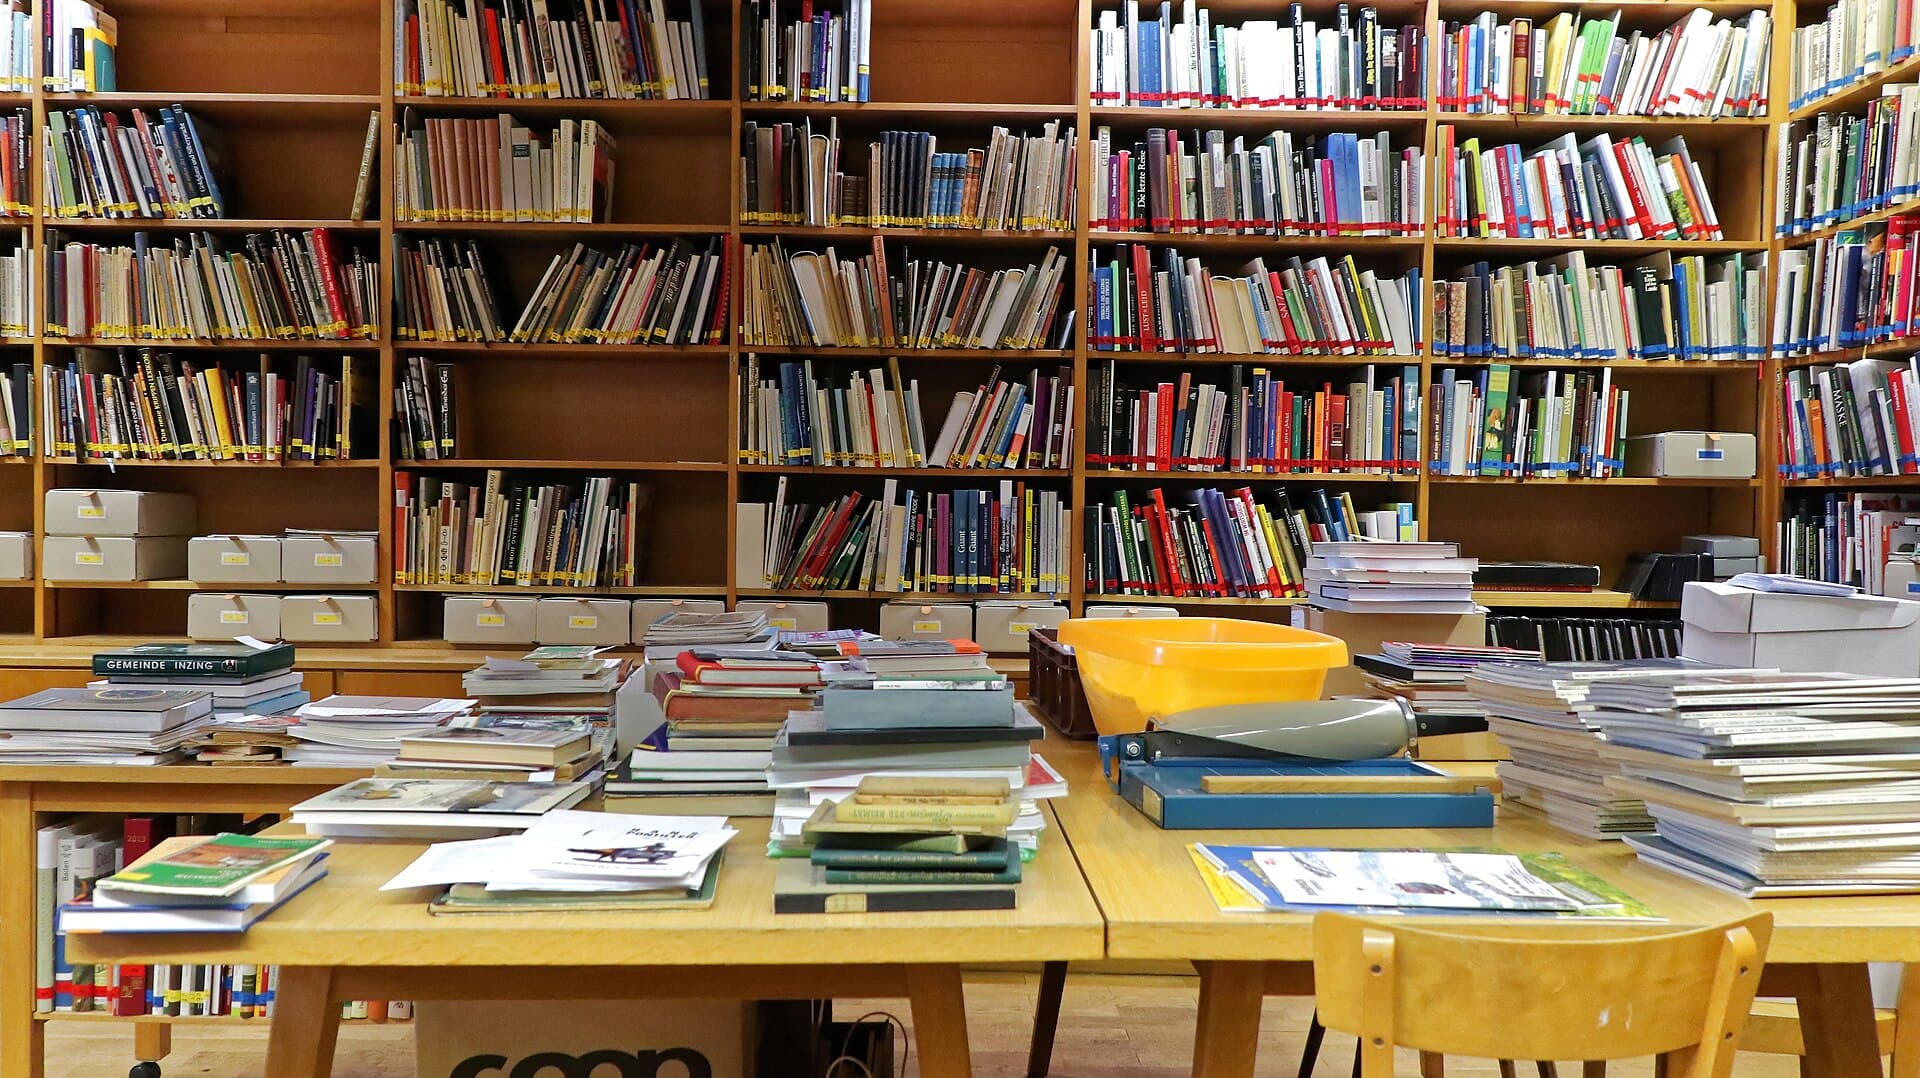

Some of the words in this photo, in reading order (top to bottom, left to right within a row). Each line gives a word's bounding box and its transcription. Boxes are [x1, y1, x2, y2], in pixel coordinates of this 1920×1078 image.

[1101, 131, 1109, 166] GEBURT
[1138, 150, 1146, 170] Reise
[1137, 171, 1146, 192] letzte
[1138, 194, 1146, 208] Die
[1276, 294, 1289, 318] SALZ
[143, 354, 156, 381] LEXIKON
[149, 382, 161, 410] KRIPPEN
[1564, 379, 1572, 398] BROT
[1563, 400, 1571, 415] DAS
[1833, 389, 1847, 426] MASKE
[1236, 502, 1248, 529] WIRTSHAUS
[958, 531, 966, 553] Guant
[969, 531, 977, 553] Guant
[106, 661, 166, 670] GEMEINDE
[174, 661, 213, 670] INZING
